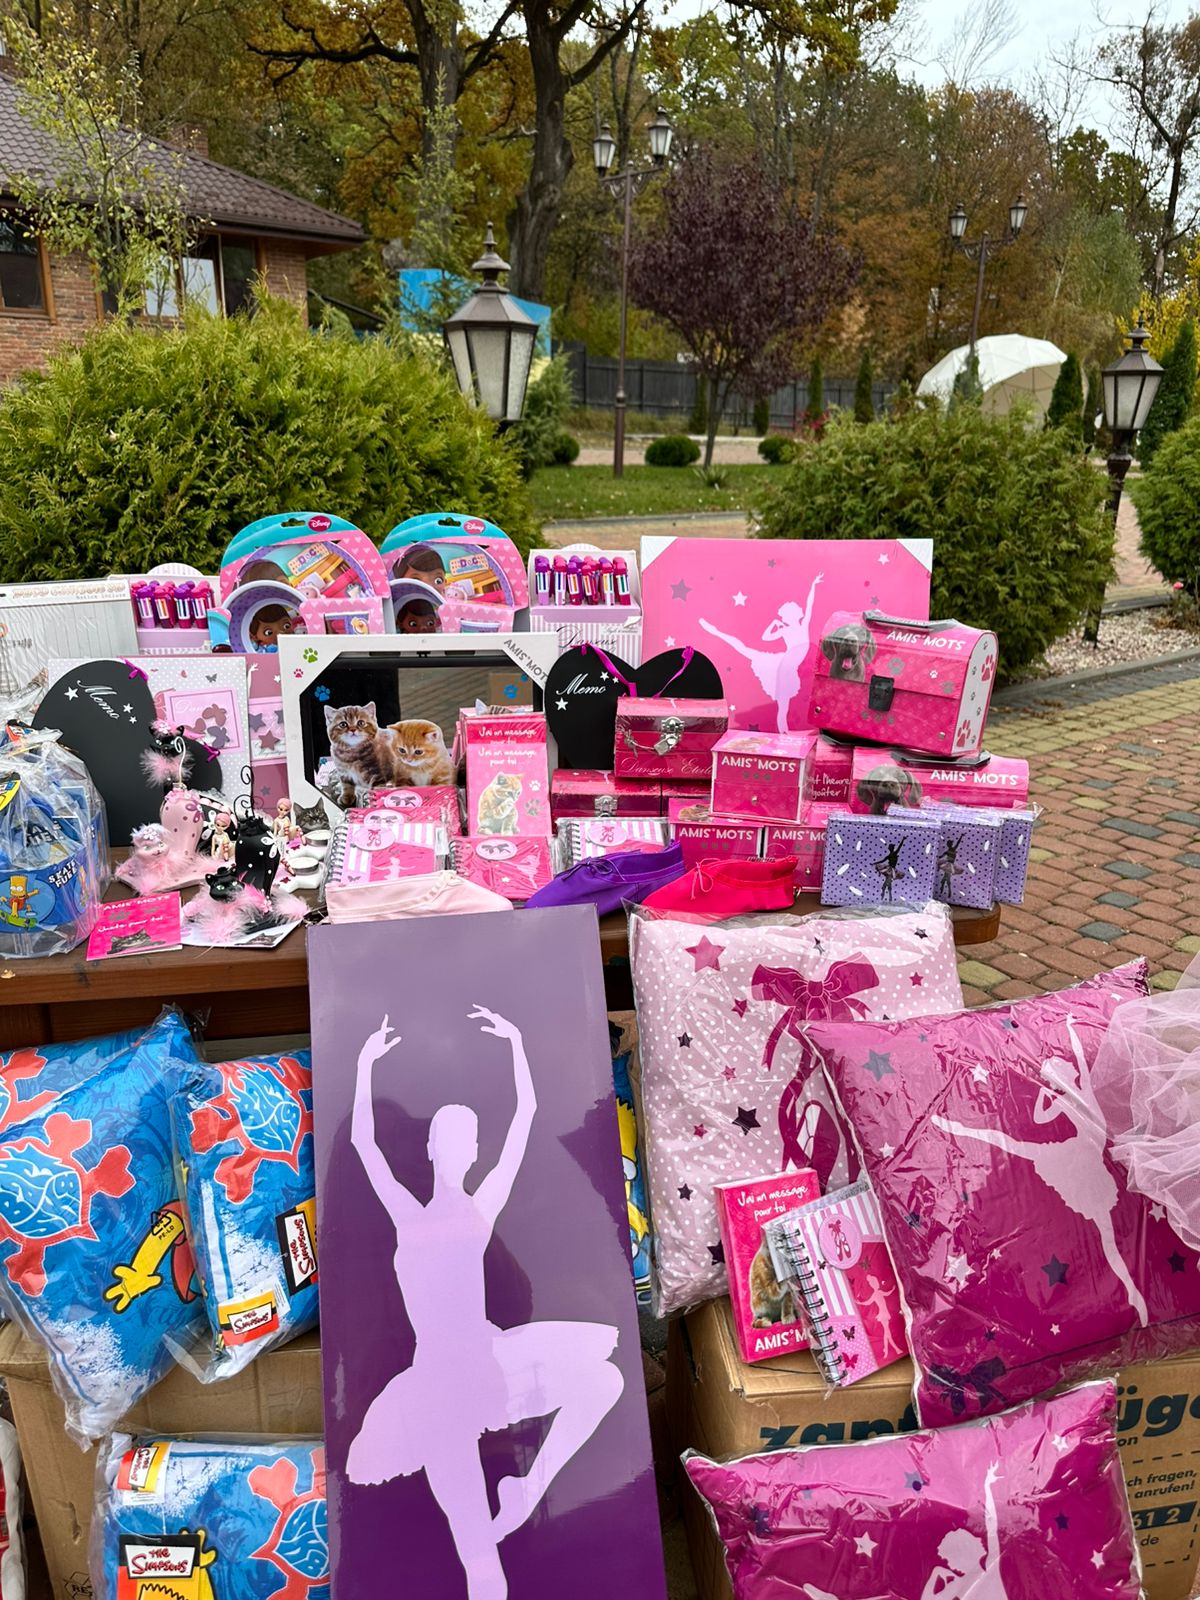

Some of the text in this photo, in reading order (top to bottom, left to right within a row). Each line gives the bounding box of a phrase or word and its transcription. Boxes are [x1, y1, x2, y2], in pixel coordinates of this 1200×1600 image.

[310, 519, 331, 529] Disney
[466, 521, 486, 532] Disney
[555, 673, 607, 695] Memo
[76, 680, 120, 719] Memo
[48, 859, 77, 883] SKATE
[55, 867, 78, 888] FUEL
[756, 1192, 768, 1202] un
[769, 1185, 808, 1199] message
[754, 1206, 772, 1222] pour
[1117, 1436, 1138, 1447] on
[1146, 1469, 1198, 1484] fragen,
[1134, 1480, 1195, 1499] anrufen!
[148, 1548, 171, 1558] THE
[131, 1553, 188, 1575] SIMPSONS
